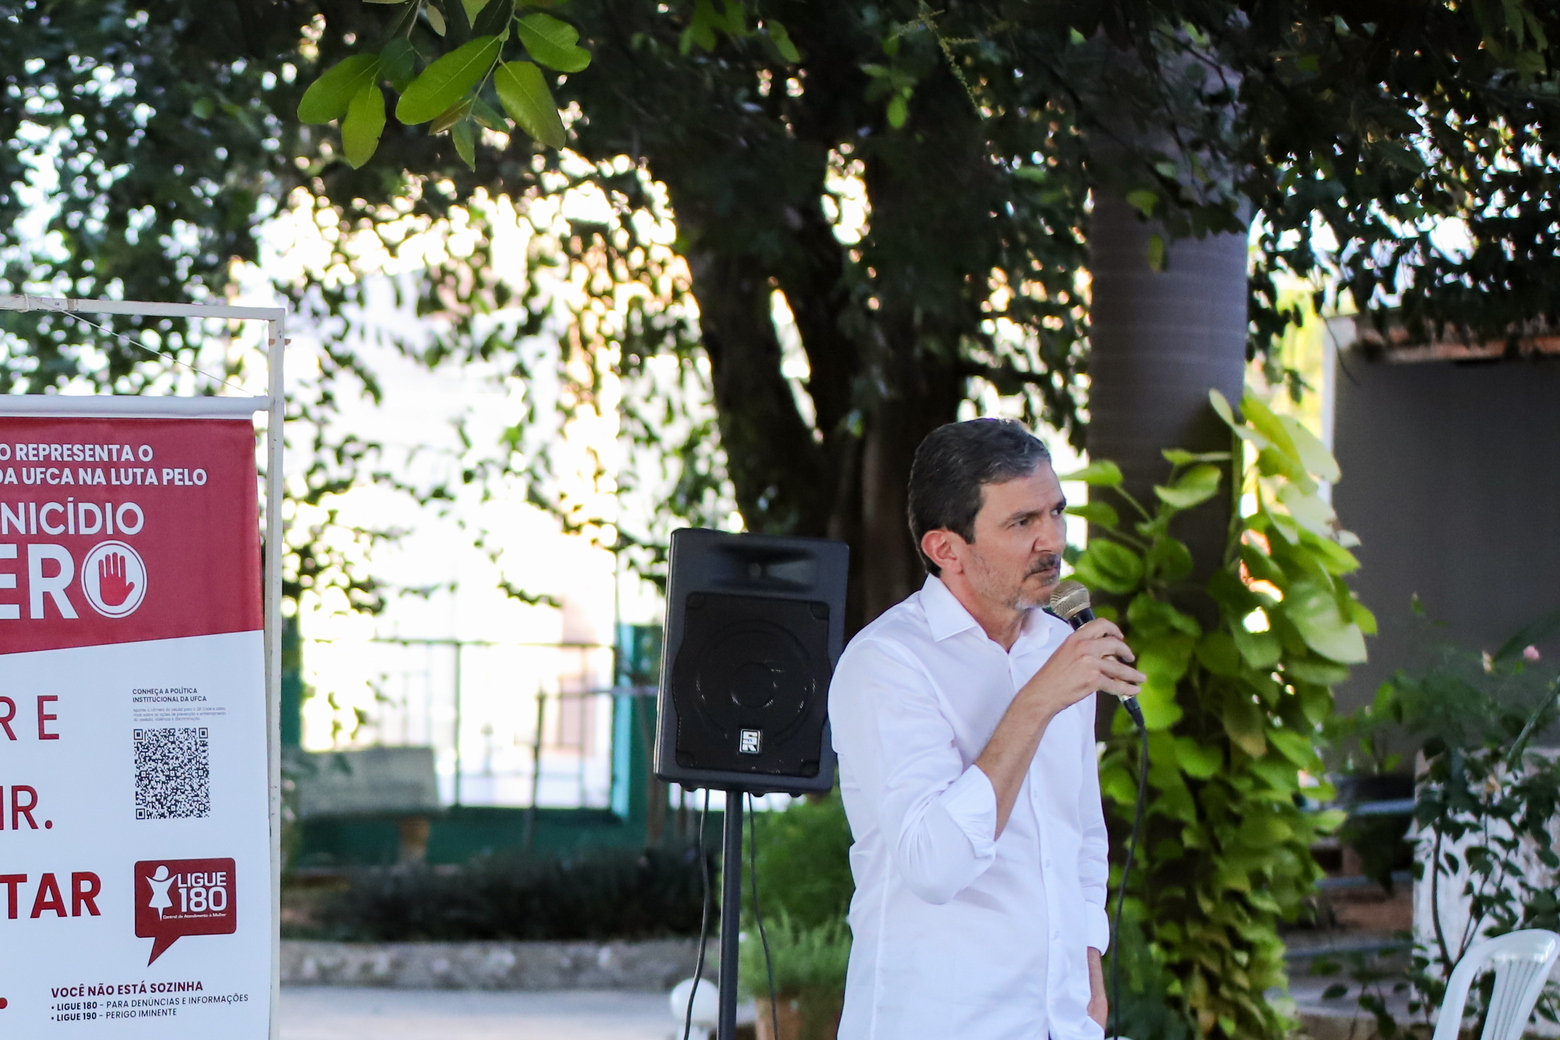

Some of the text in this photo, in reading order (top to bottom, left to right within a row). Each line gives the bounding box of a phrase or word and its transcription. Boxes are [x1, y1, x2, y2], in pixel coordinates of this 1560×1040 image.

[16, 444, 134, 462] REPRESENTA
[138, 445, 154, 462] O
[22, 468, 74, 485] UFCA
[78, 468, 106, 485] NA
[110, 468, 158, 486] LUTA
[162, 468, 208, 486] PELO
[171, 686, 197, 694] POLÍTICA
[38, 695, 60, 740] E
[178, 872, 227, 887] LIGUE
[178, 886, 227, 912] 180
[51, 980, 203, 998] VOCÊ NÃO ESTÁ SOZINHA
[57, 1002, 81, 1011] LIGUE
[83, 1001, 97, 1010] 180
[106, 1000, 129, 1009] PARA
[131, 997, 180, 1008] DENÚNCIAS
[188, 993, 249, 1005] INFORMAÇÕES
[57, 1013, 81, 1022] LIGUE
[83, 1012, 97, 1020] 190
[106, 1010, 137, 1020] PERIGO
[139, 1008, 177, 1017] IMINENTE
